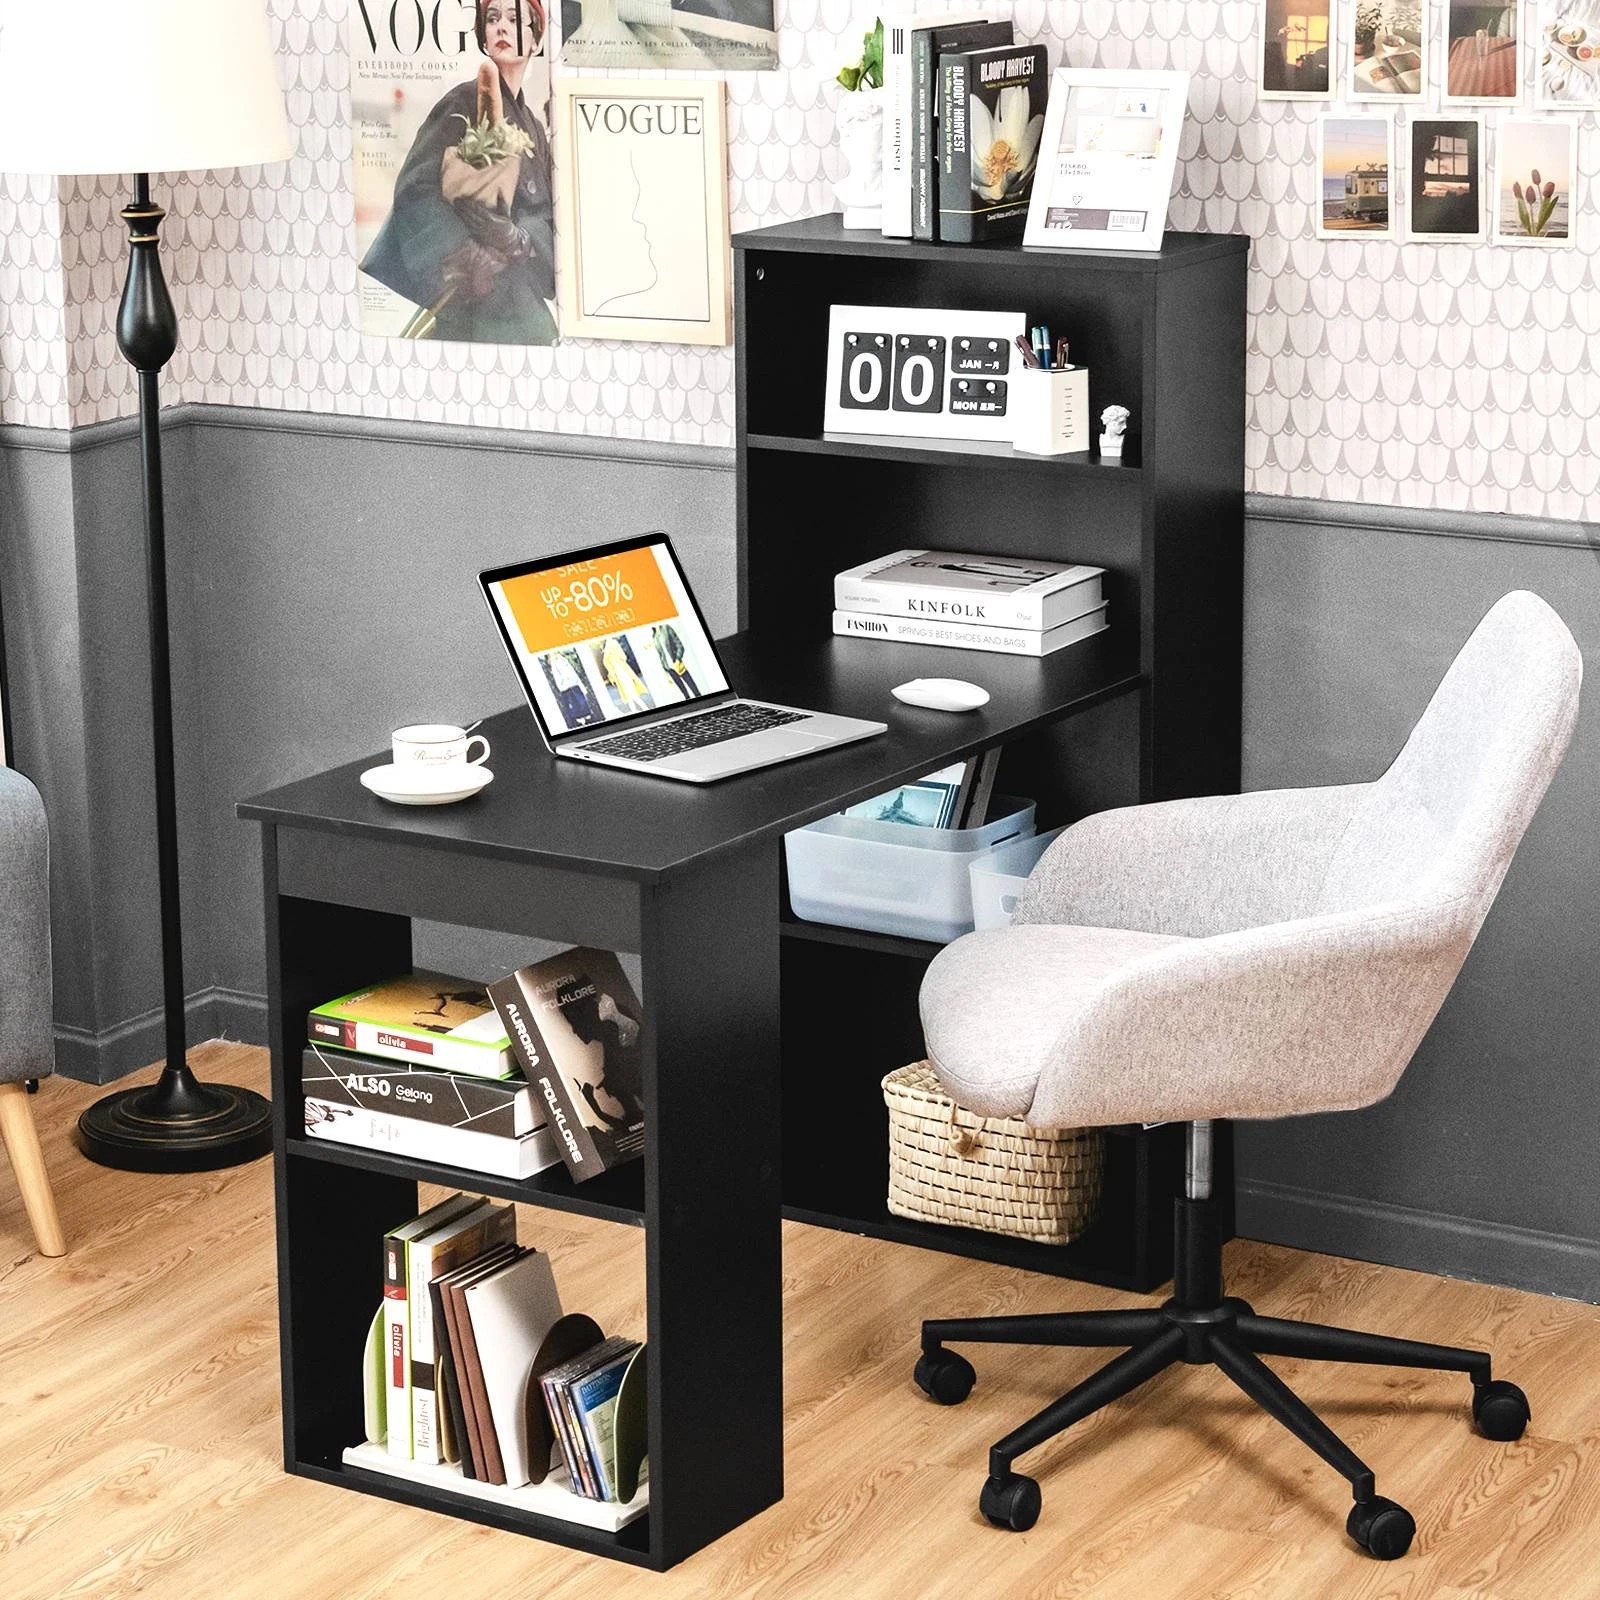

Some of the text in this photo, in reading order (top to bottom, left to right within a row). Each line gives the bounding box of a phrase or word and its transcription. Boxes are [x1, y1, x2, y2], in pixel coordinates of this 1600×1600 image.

[357, 60, 459, 72] EVERYBODY COOKS!
[980, 55, 1035, 82] BLOODY HARVEST
[578, 103, 702, 135] VOGUE
[952, 65, 966, 153] BLOODY HARVEST
[959, 359, 982, 369] JAN
[849, 352, 935, 405] 0 0
[952, 400, 978, 411] MON
[540, 586, 562, 606] UP
[548, 602, 569, 620] TO
[907, 598, 986, 618] KINFOLK
[847, 619, 889, 633] FASHION
[935, 630, 953, 641] BEST
[955, 631, 981, 644] SHOES
[982, 635, 1002, 646] AND
[1003, 638, 1027, 649] BAGS
[535, 974, 577, 996] AURORA
[542, 983, 597, 1012] FOLKLORE
[346, 1072, 391, 1098] ALSO
[395, 1084, 434, 1105] Gelang
[505, 1003, 584, 1165] AURORA FOLKLORE
